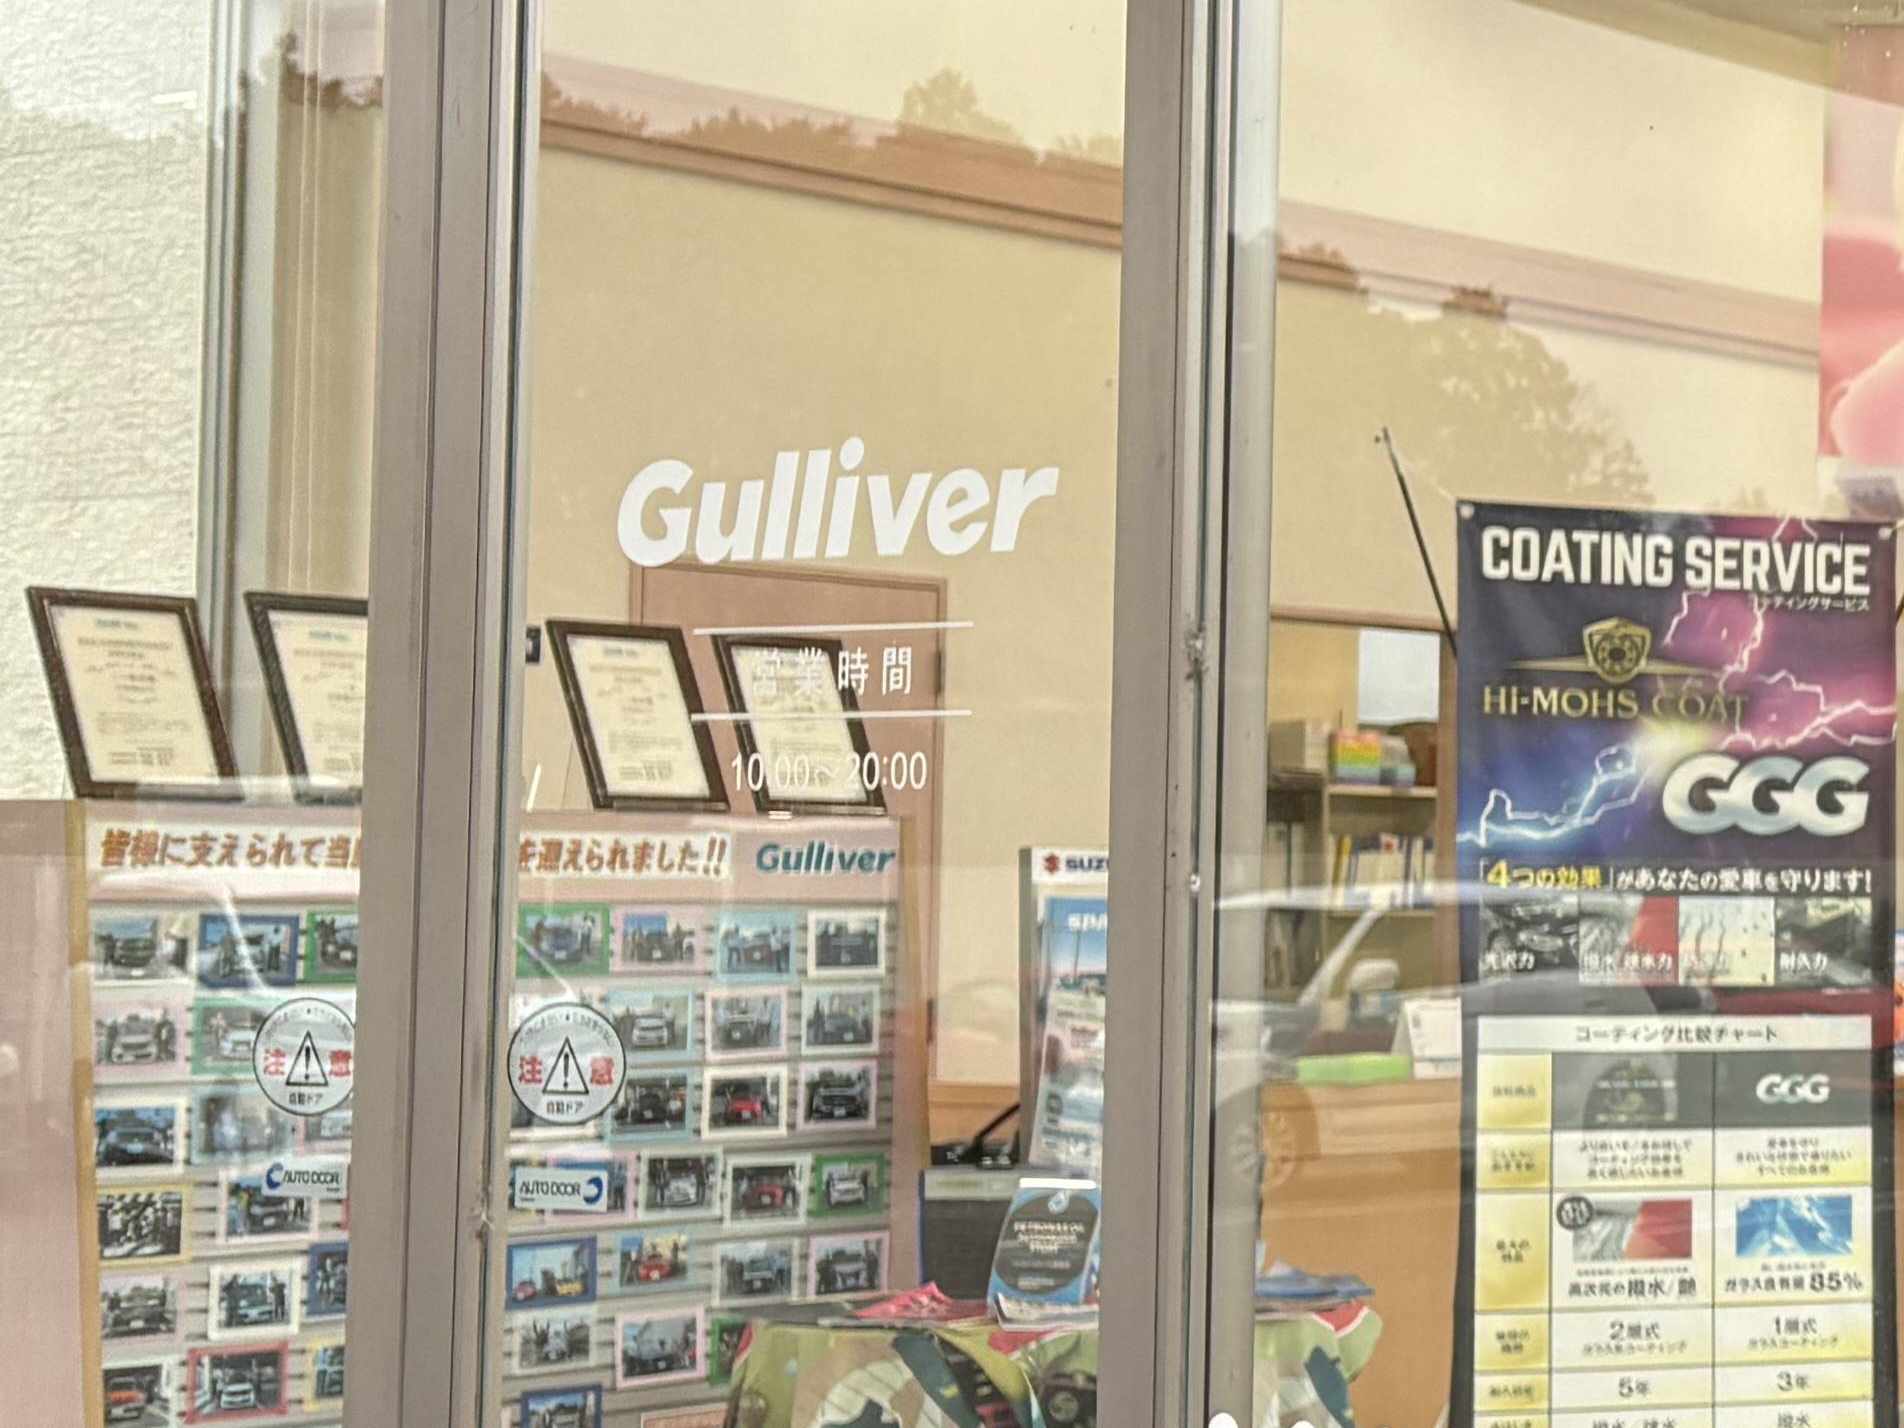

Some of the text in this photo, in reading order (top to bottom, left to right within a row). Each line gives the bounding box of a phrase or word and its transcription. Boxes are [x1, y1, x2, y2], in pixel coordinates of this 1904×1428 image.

[616, 437, 1060, 567] Gulliver
[1481, 525, 1871, 596] COATING SERVICE
[752, 646, 912, 697] 営業時間
[1652, 691, 1749, 726] COAT
[1662, 754, 1870, 836] GGG
[101, 827, 362, 869] 皆様に支えられて当
[756, 839, 897, 876] Gulliver
[1755, 1073, 1831, 1105] GGG
[283, 1169, 310, 1185] AUTO
[519, 1179, 550, 1196] AUTO
[1618, 1376, 1651, 1397] 5年
[1777, 1371, 1809, 1392] 3年
